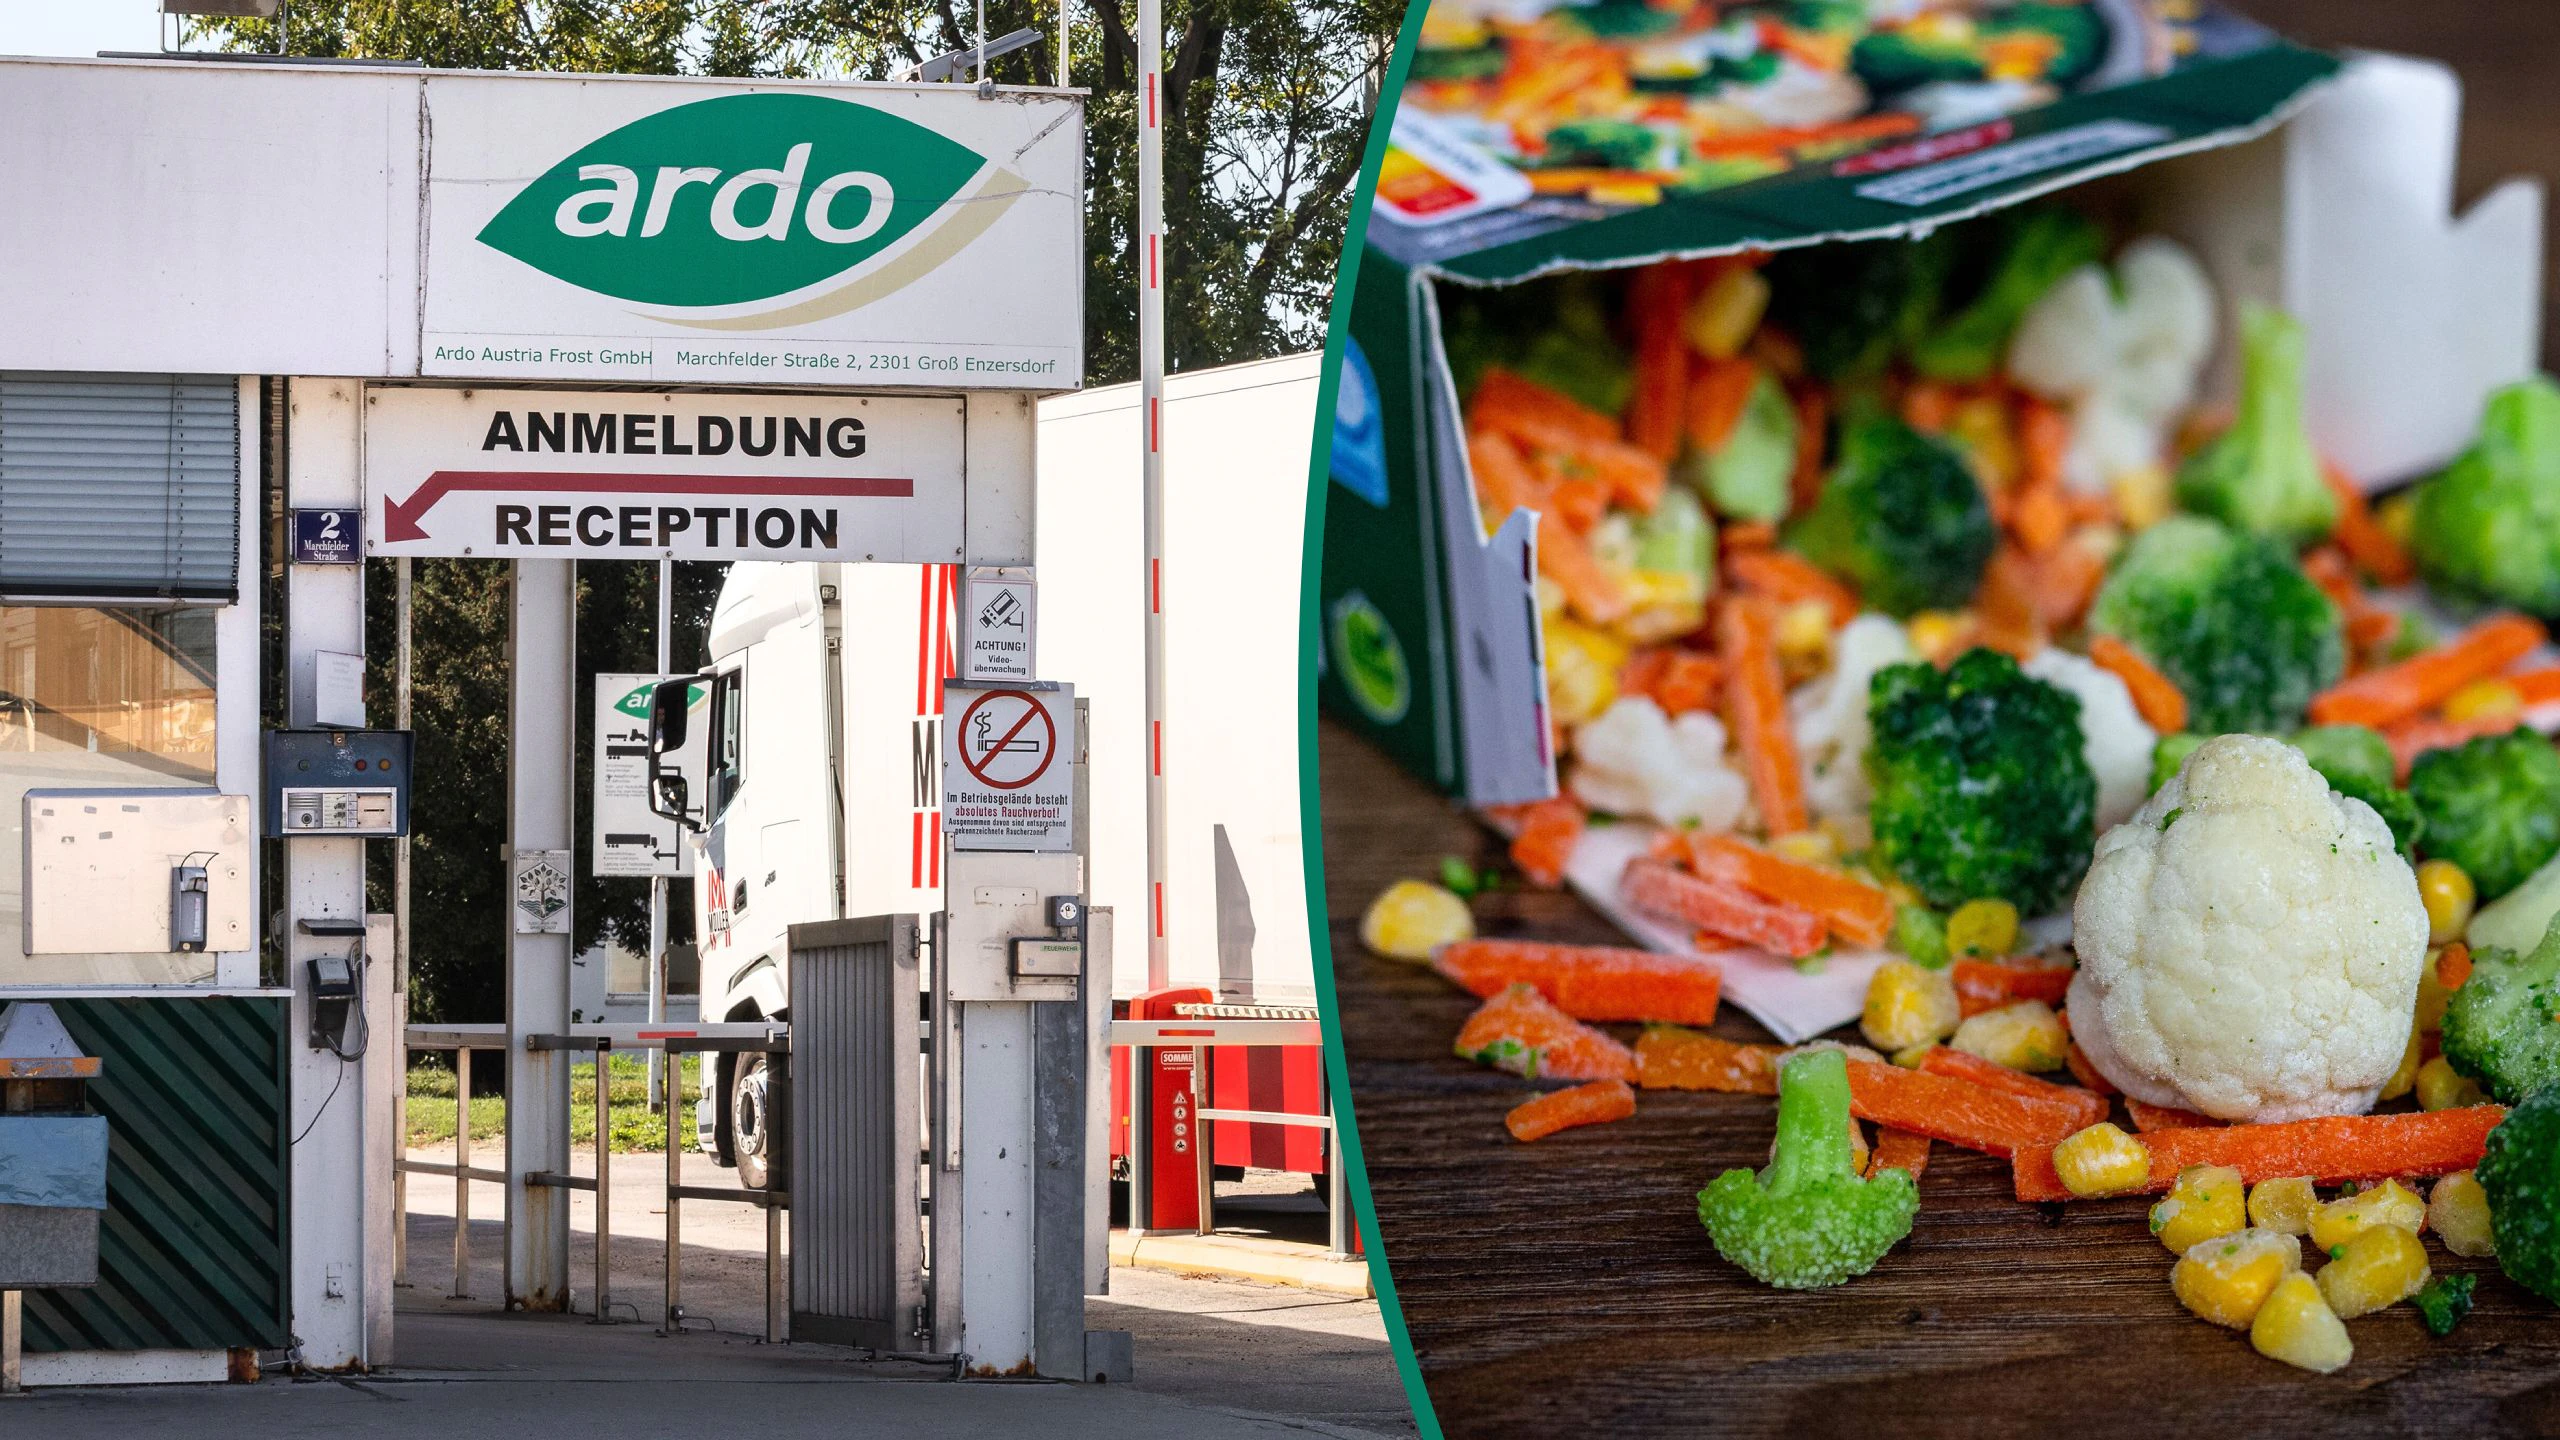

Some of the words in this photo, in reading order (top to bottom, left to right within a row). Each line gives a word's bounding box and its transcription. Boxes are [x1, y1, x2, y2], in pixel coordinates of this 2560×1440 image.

[554, 142, 894, 244] ardo
[435, 346, 475, 361] Ardo
[482, 347, 543, 362] Austria
[550, 348, 593, 363] Frost
[600, 350, 653, 364] GmbH
[676, 351, 778, 367] Marchfelder
[784, 353, 839, 369] Straße
[847, 354, 861, 371] 2,
[869, 355, 910, 370] 2301
[917, 356, 959, 371] Groß
[965, 357, 1056, 373] Enzersdorf
[481, 411, 867, 459] ANMELDUNG
[320, 512, 341, 539] 2
[496, 504, 839, 549] RECEPTION
[304, 539, 350, 551] Marchfelder
[313, 550, 339, 561] Straße
[974, 640, 1026, 652] ACHTUNG!
[988, 654, 1013, 664] Video-
[974, 663, 1026, 675] überwachung
[626, 693, 652, 708] ar
[947, 792, 958, 803] Im
[961, 792, 1032, 805] Betriebsgelände
[1035, 794, 1068, 805] besteht
[955, 805, 998, 817] absolutes
[1001, 806, 1060, 818] Rauchverbot!
[1163, 1053, 1193, 1063] SOMME
